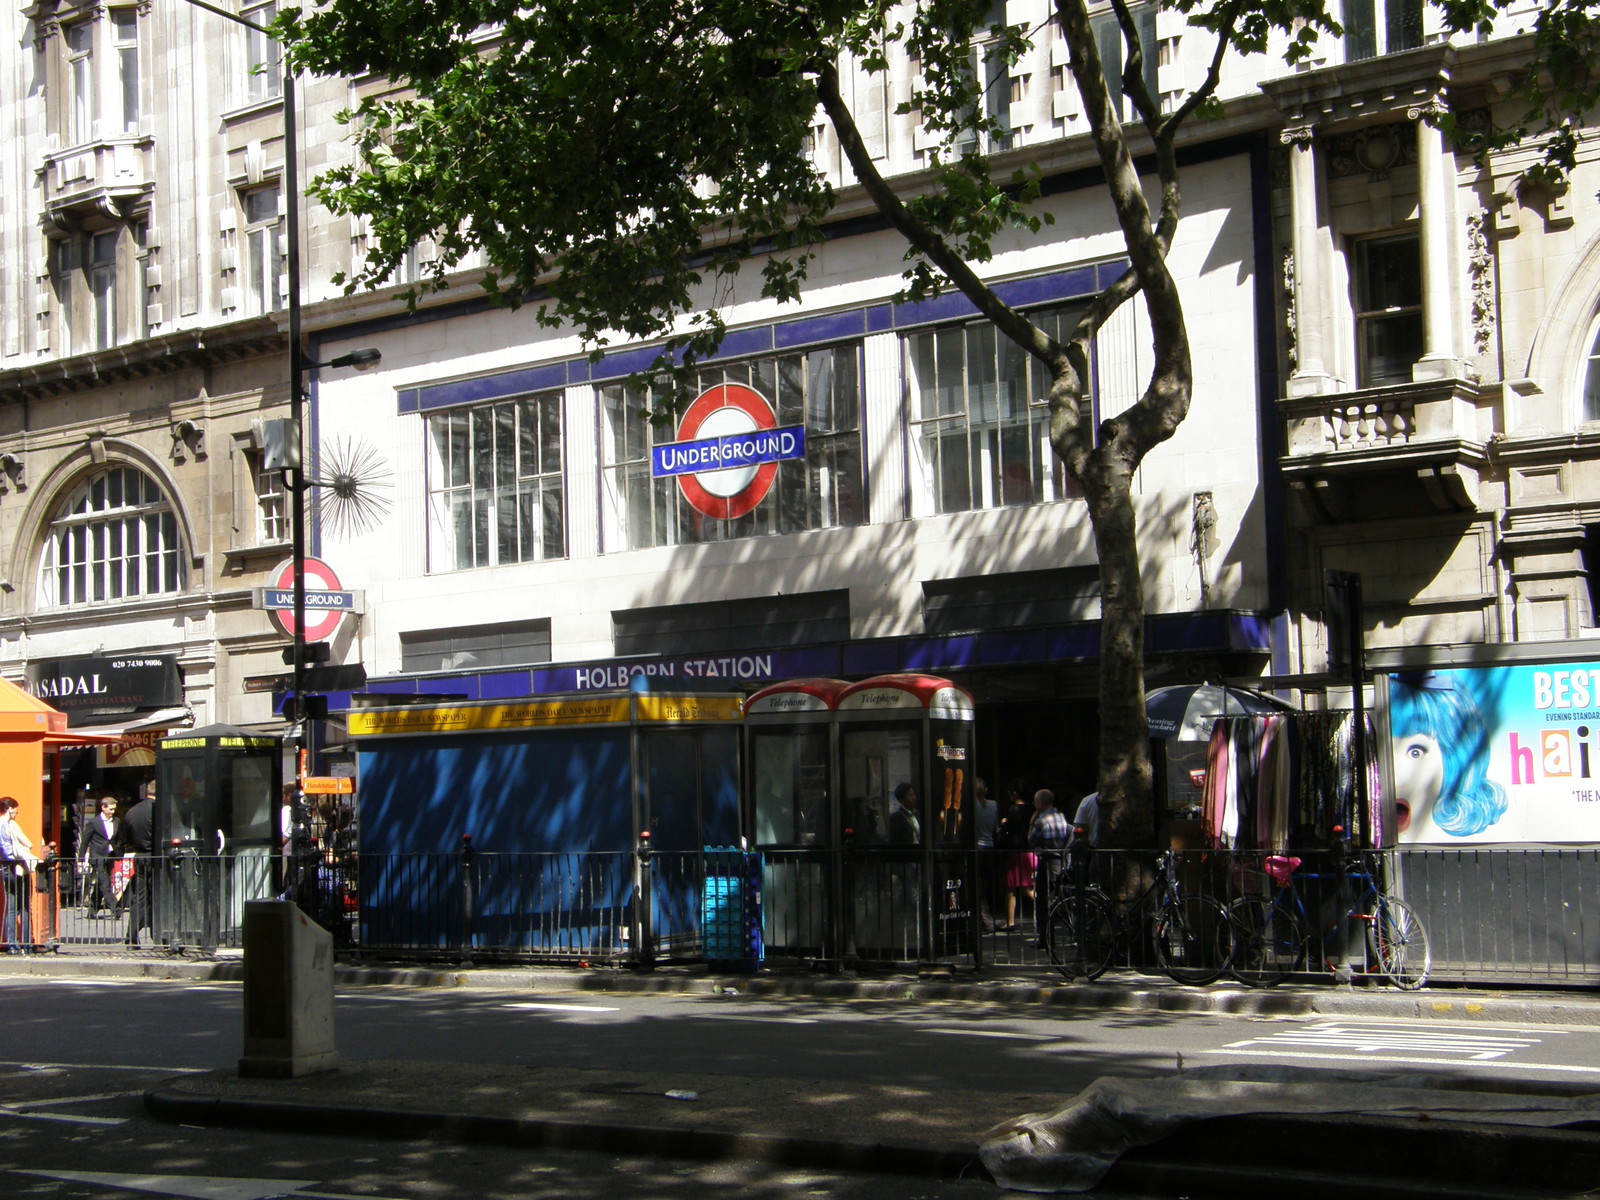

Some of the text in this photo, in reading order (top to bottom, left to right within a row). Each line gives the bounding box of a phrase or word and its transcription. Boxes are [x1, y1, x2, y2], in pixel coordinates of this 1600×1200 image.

[661, 432, 796, 471] UNDERGROUND
[112, 659, 162, 669] 020 7430 9006
[683, 654, 772, 679] STATION
[1533, 669, 1600, 710] BEST
[769, 698, 807, 709] Telephone
[861, 694, 900, 705] Telephone
[1545, 711, 1600, 722] EVENING STANDAR
[166, 738, 202, 748] TELEPHONE
[1508, 725, 1600, 785] hai
